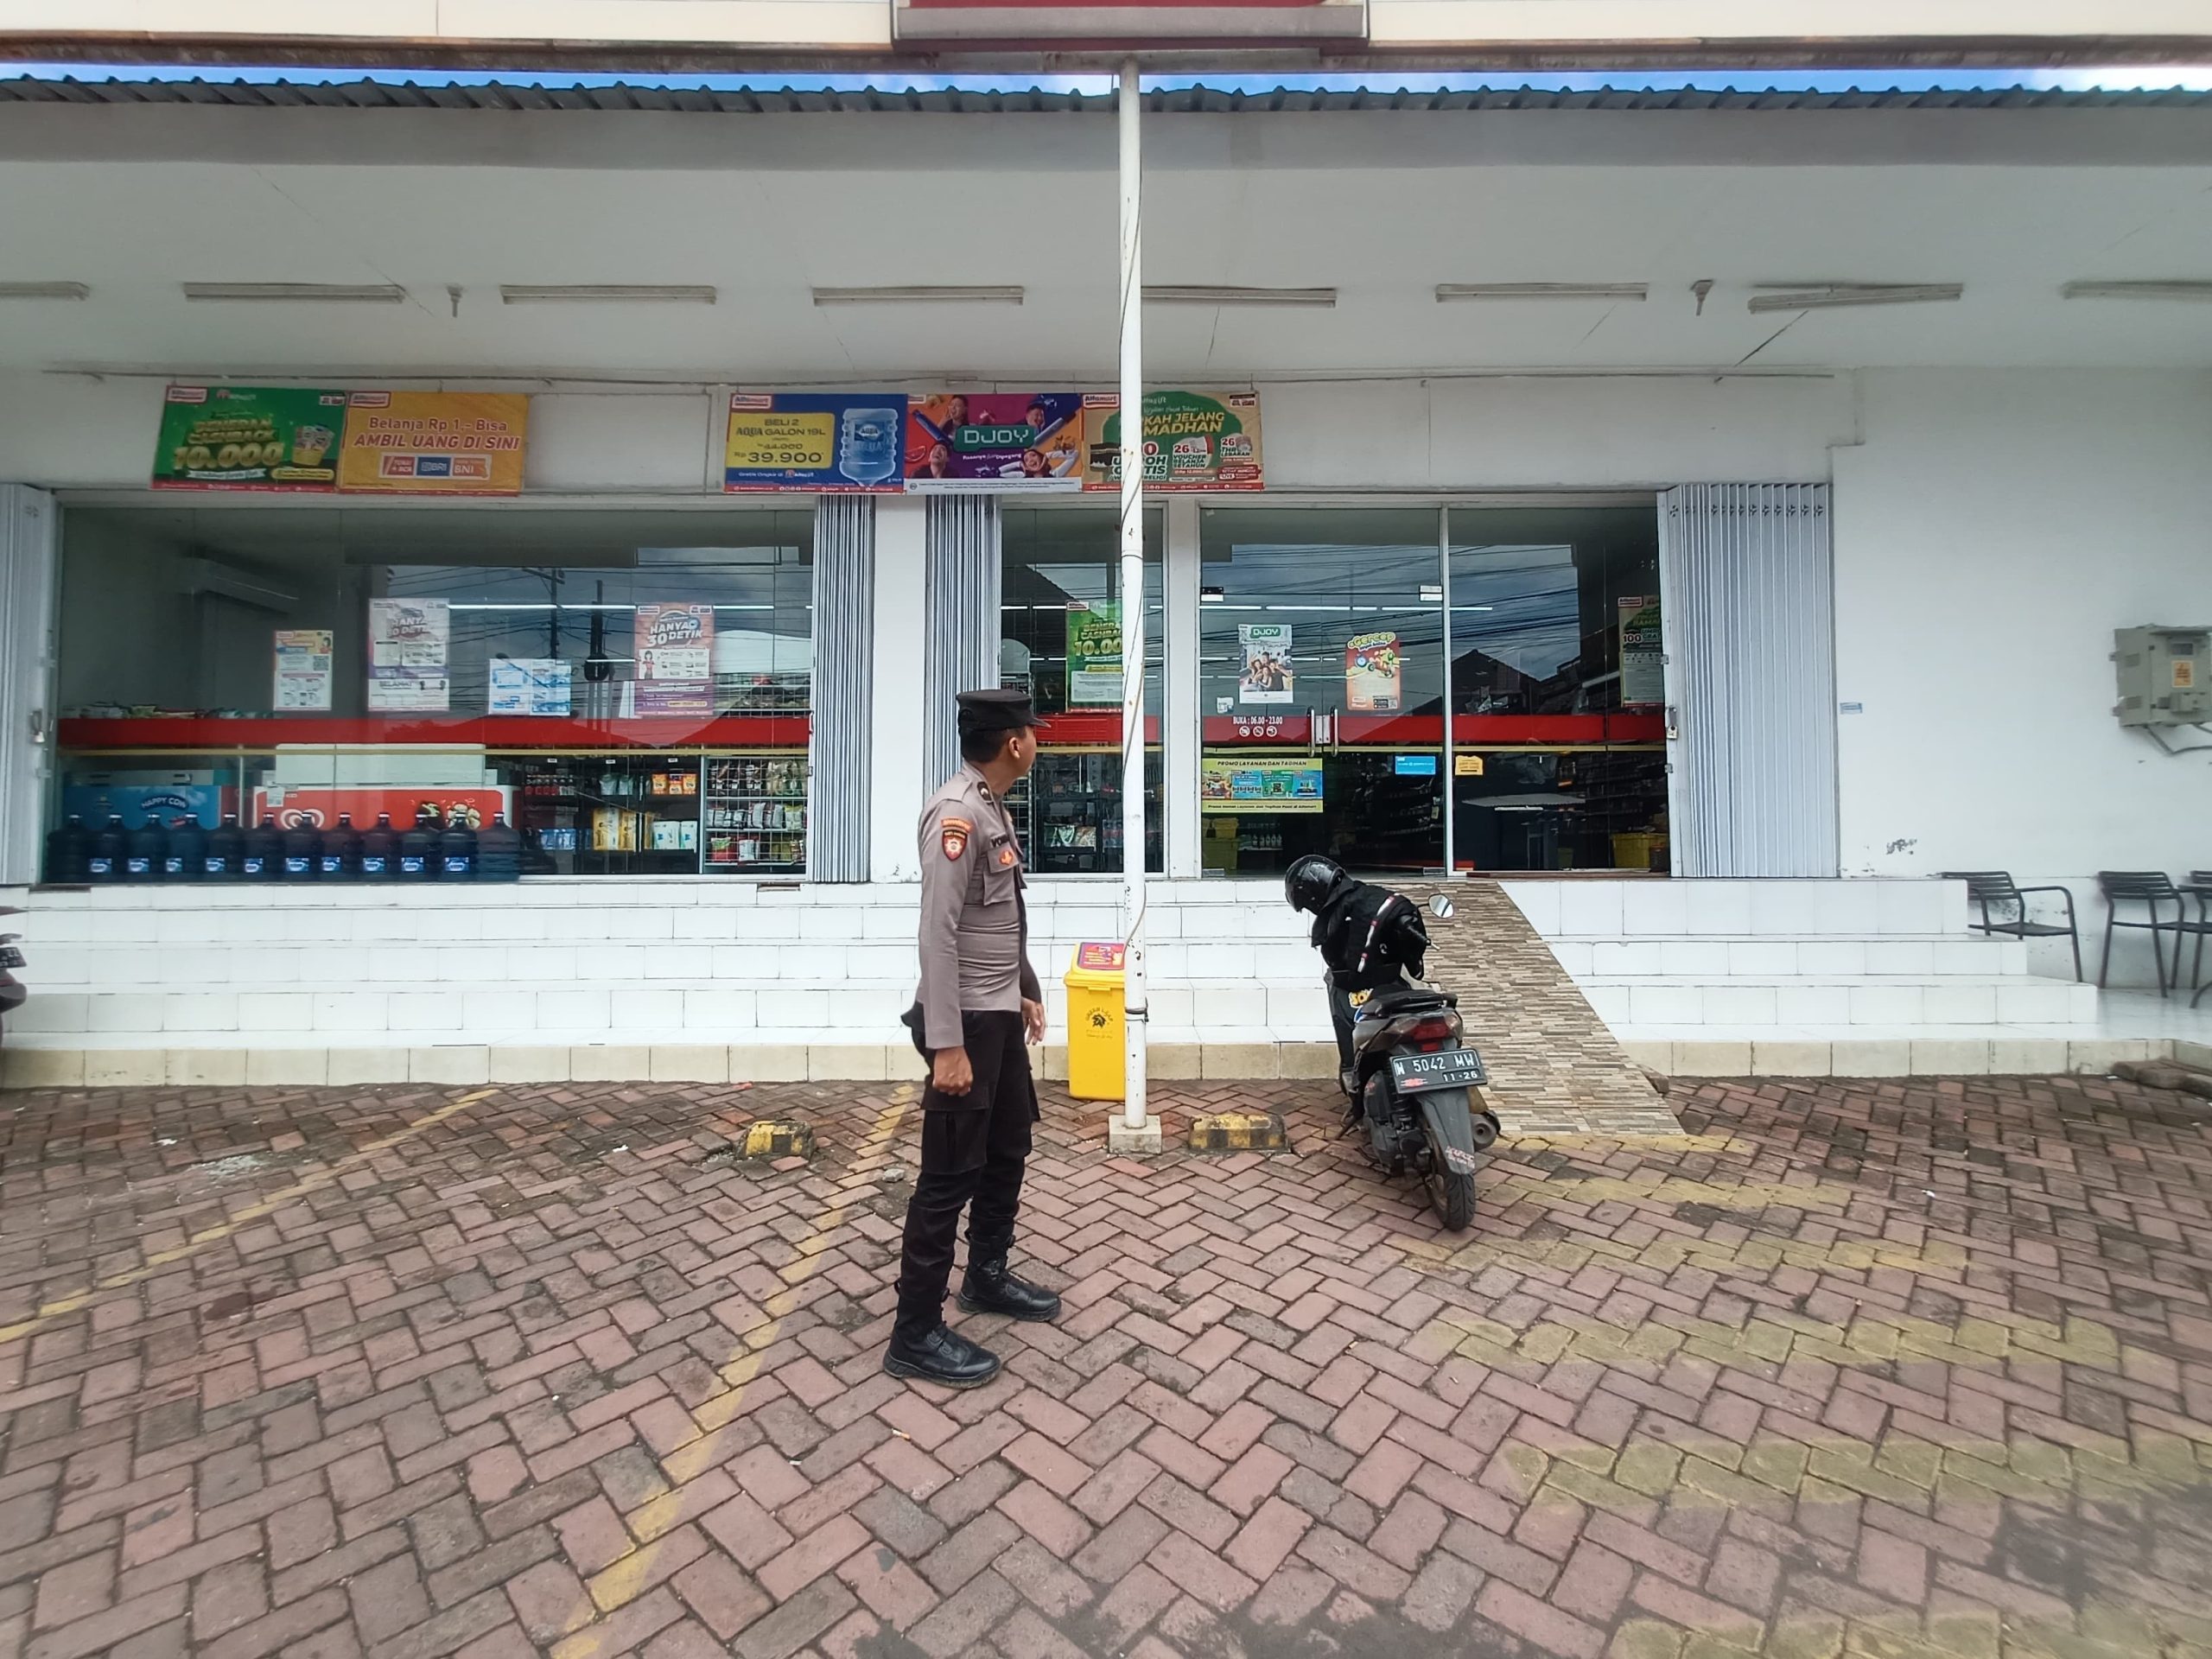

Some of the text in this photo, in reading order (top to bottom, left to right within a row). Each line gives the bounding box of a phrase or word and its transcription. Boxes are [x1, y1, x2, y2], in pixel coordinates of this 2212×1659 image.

[369, 417, 424, 432] Belanja
[429, 418, 448, 432] Rp
[475, 419, 508, 431] Bisa
[1144, 411, 1225, 425] KAH JELANG
[765, 428, 804, 436] GALON
[807, 428, 826, 436] 19L
[1143, 422, 1224, 436] MADHAN
[353, 434, 520, 449] AMBIL UANG DI SINI
[963, 429, 1029, 444] DJOY
[1221, 438, 1236, 447] 26
[174, 442, 286, 470] 10.000
[1173, 444, 1191, 454] 26
[747, 452, 823, 463] 39.900
[431, 462, 448, 471] BRI
[454, 464, 474, 474] BNI
[650, 620, 691, 635] HANYA
[647, 630, 704, 646] 30 DETIK
[1623, 634, 1642, 643] 100
[1074, 637, 1122, 656] 10.00
[1232, 715, 1247, 725] BUKA
[1268, 715, 1283, 725] 23.00
[141, 797, 168, 809] HAPPY
[1395, 1052, 1475, 1076] N 5042 MW
